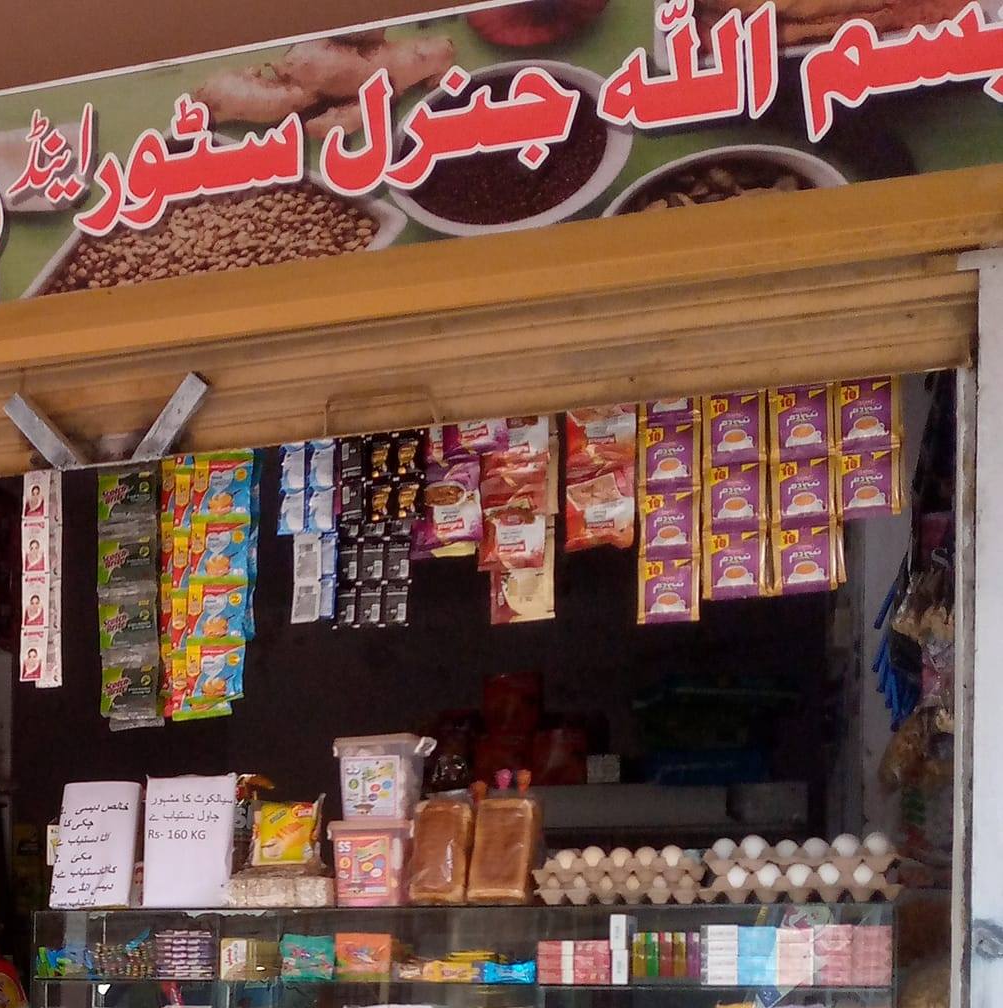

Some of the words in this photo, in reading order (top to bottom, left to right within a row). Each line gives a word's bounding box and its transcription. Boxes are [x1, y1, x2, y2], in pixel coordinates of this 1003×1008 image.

[75, 92, 306, 237] سٹور
[320, 59, 581, 196] جنرل
[168, 830, 188, 839] 160
[191, 830, 206, 839] KG
